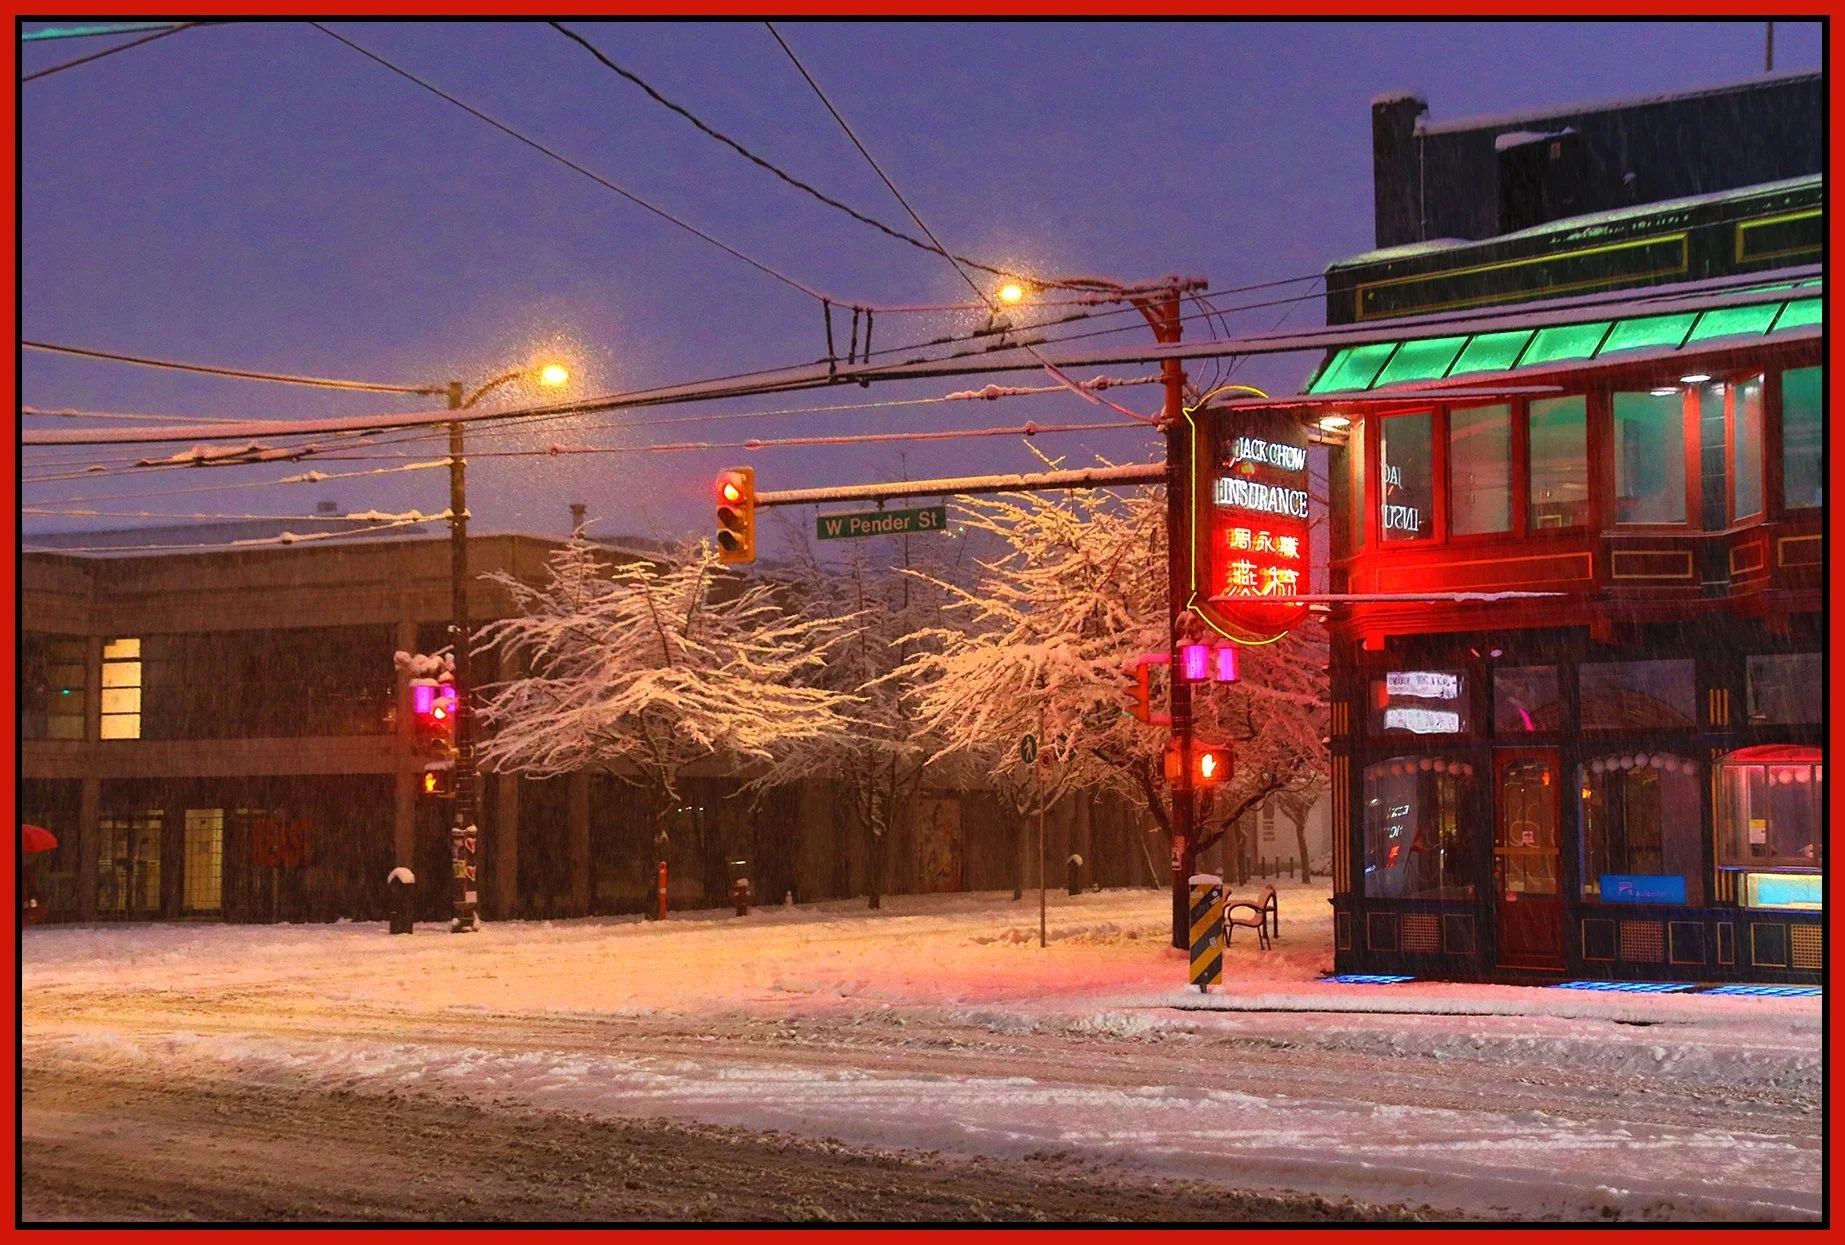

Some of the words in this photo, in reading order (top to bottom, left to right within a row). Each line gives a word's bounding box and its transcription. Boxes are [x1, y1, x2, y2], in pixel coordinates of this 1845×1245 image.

[1235, 437, 1268, 462] JACK
[1268, 443, 1307, 471] CHOW
[1216, 477, 1309, 518] INSURANCE
[825, 519, 842, 536] W
[850, 514, 911, 534] Pender
[918, 511, 938, 528] St
